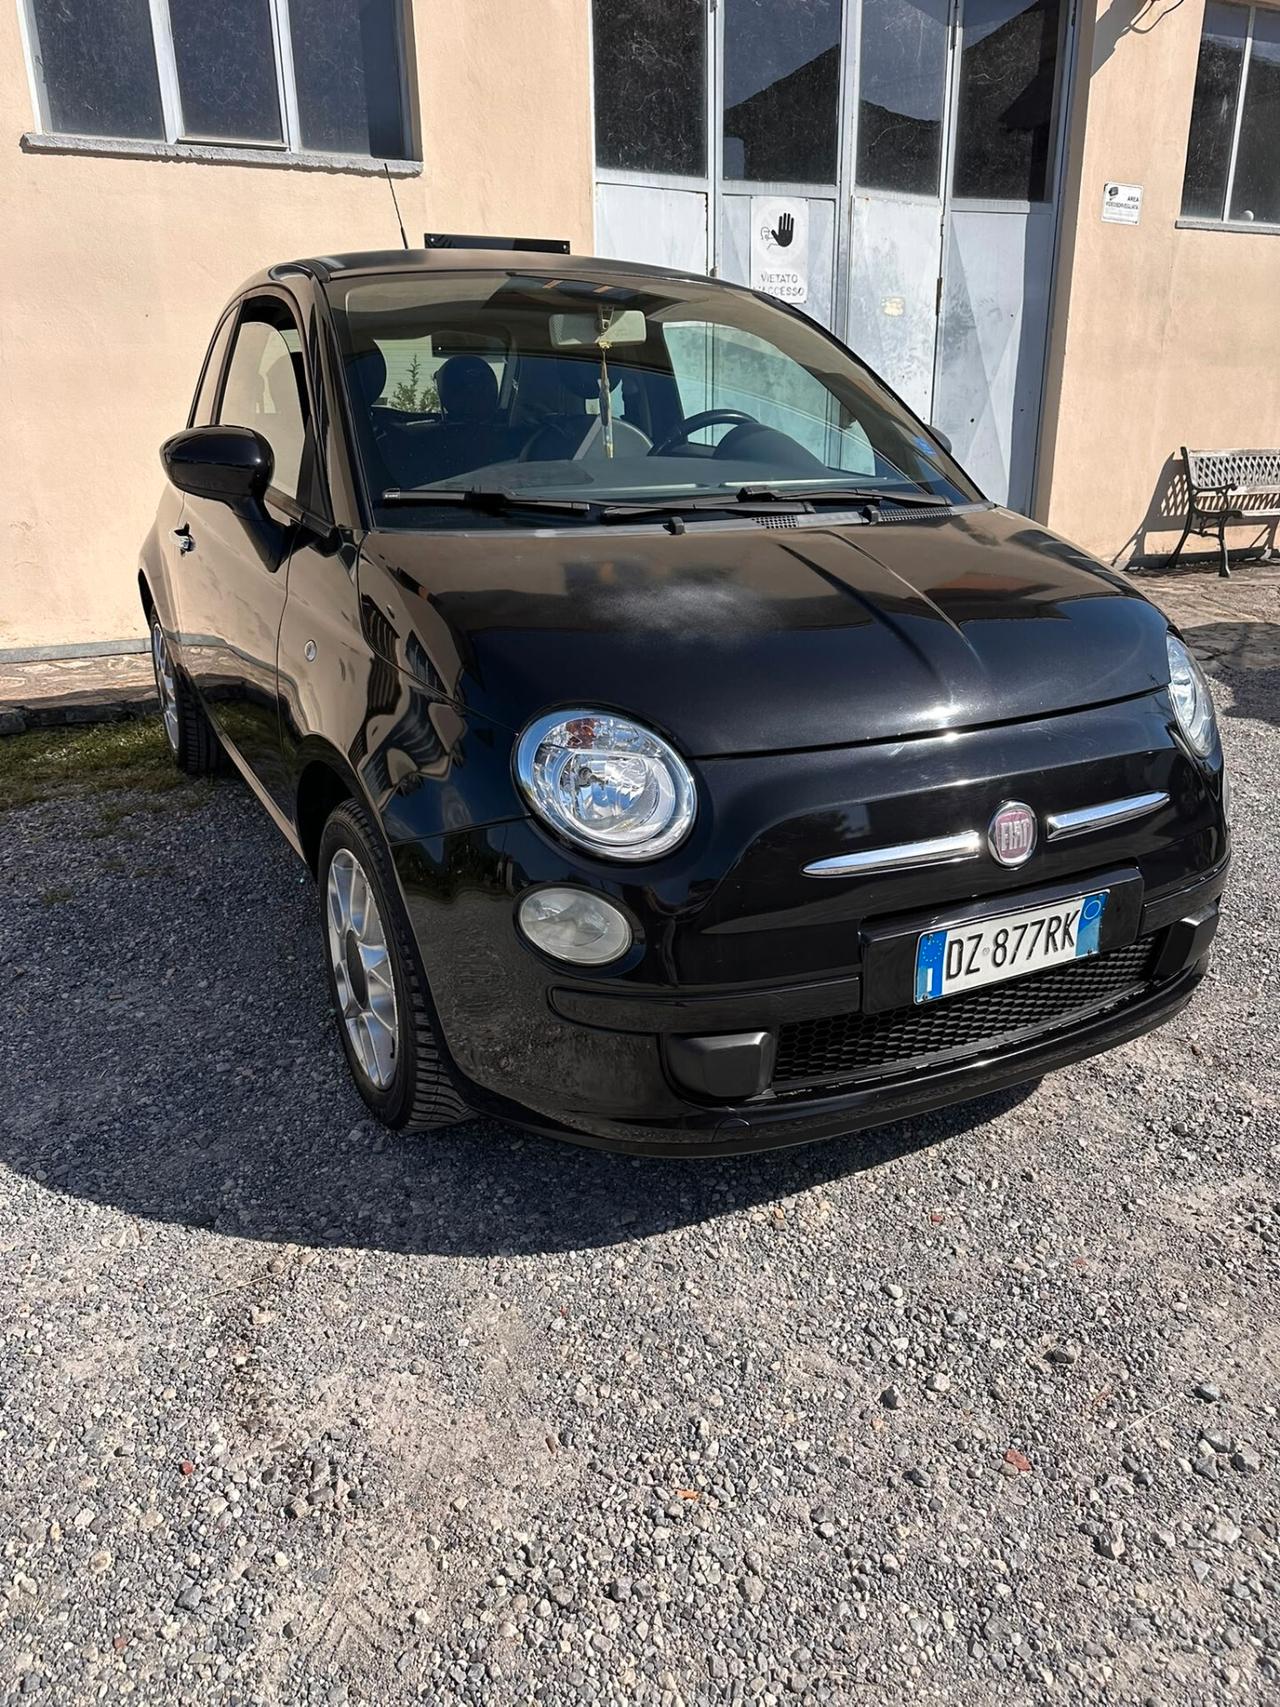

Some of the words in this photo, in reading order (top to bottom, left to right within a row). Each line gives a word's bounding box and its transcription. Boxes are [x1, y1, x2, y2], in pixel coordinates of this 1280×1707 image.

[760, 273, 798, 284] VIETATO
[1000, 818, 1029, 851] FIAT
[991, 909, 1080, 968] 877RK
